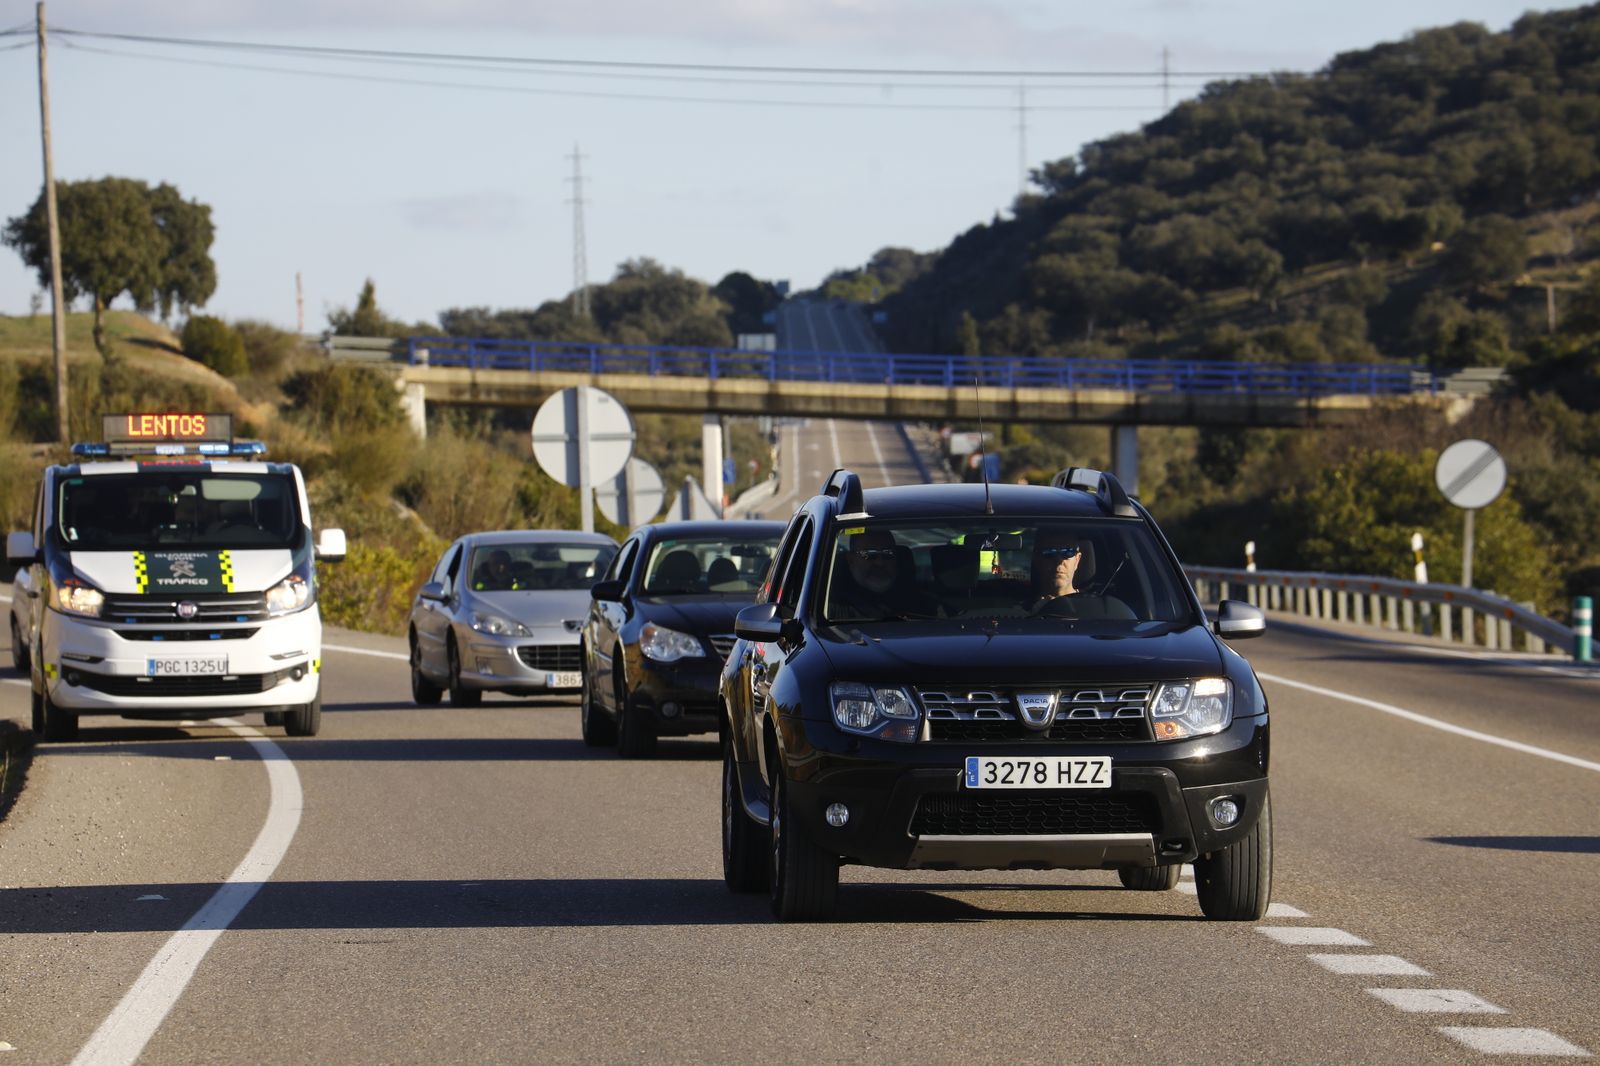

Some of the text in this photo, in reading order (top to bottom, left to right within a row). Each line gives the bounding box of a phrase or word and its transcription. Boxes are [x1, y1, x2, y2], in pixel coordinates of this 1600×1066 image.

[127, 414, 206, 437] LENTOS
[156, 660, 180, 673] PGC
[984, 761, 1048, 784] 3278
[1057, 761, 1104, 784] HZZ
